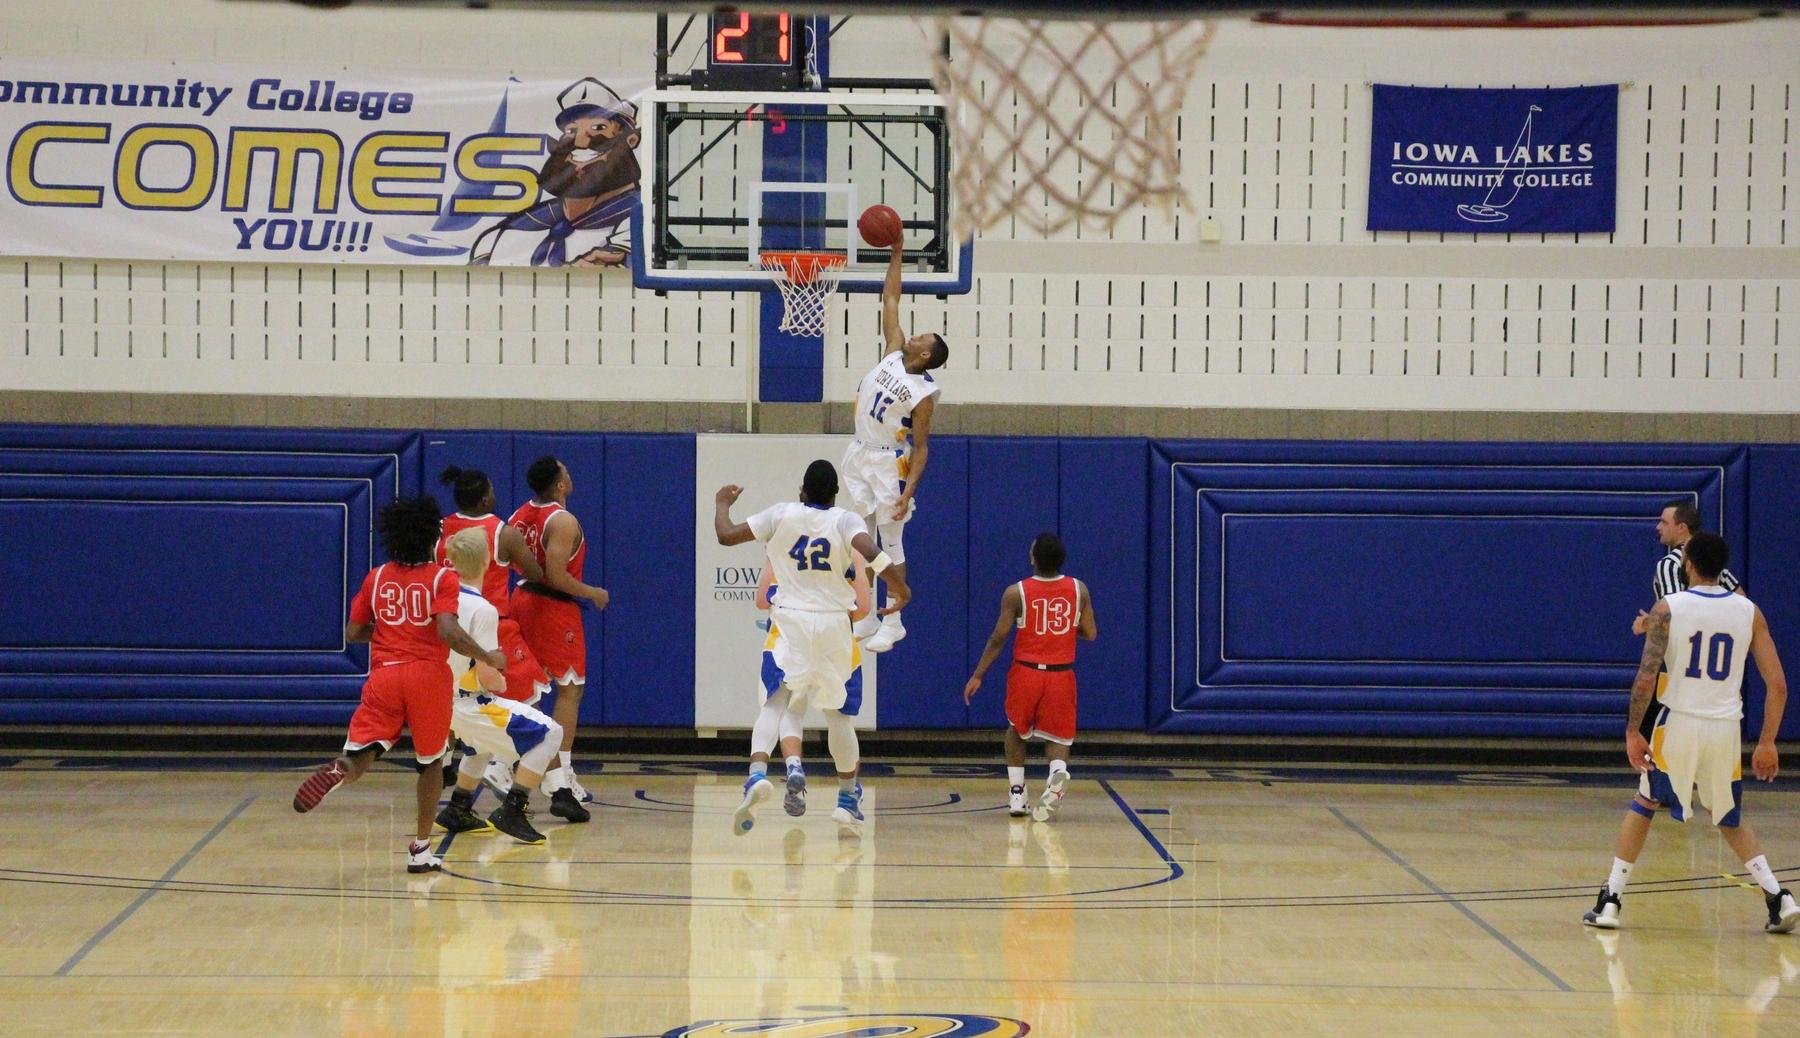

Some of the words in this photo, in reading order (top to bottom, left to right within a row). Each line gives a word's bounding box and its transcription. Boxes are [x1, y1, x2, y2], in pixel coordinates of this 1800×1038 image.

[247, 78, 414, 121] College
[6, 119, 547, 216] COMES
[1393, 142, 1479, 163] IOWA
[1495, 143, 1593, 164] LAKES
[1392, 172, 1505, 187] COMMUNITY
[1513, 173, 1593, 188] COLLEGE
[233, 217, 373, 252] YOU!!!
[788, 534, 832, 572] 42
[379, 581, 433, 626] 30
[1032, 597, 1071, 635] 13
[1685, 630, 1734, 681] 10
